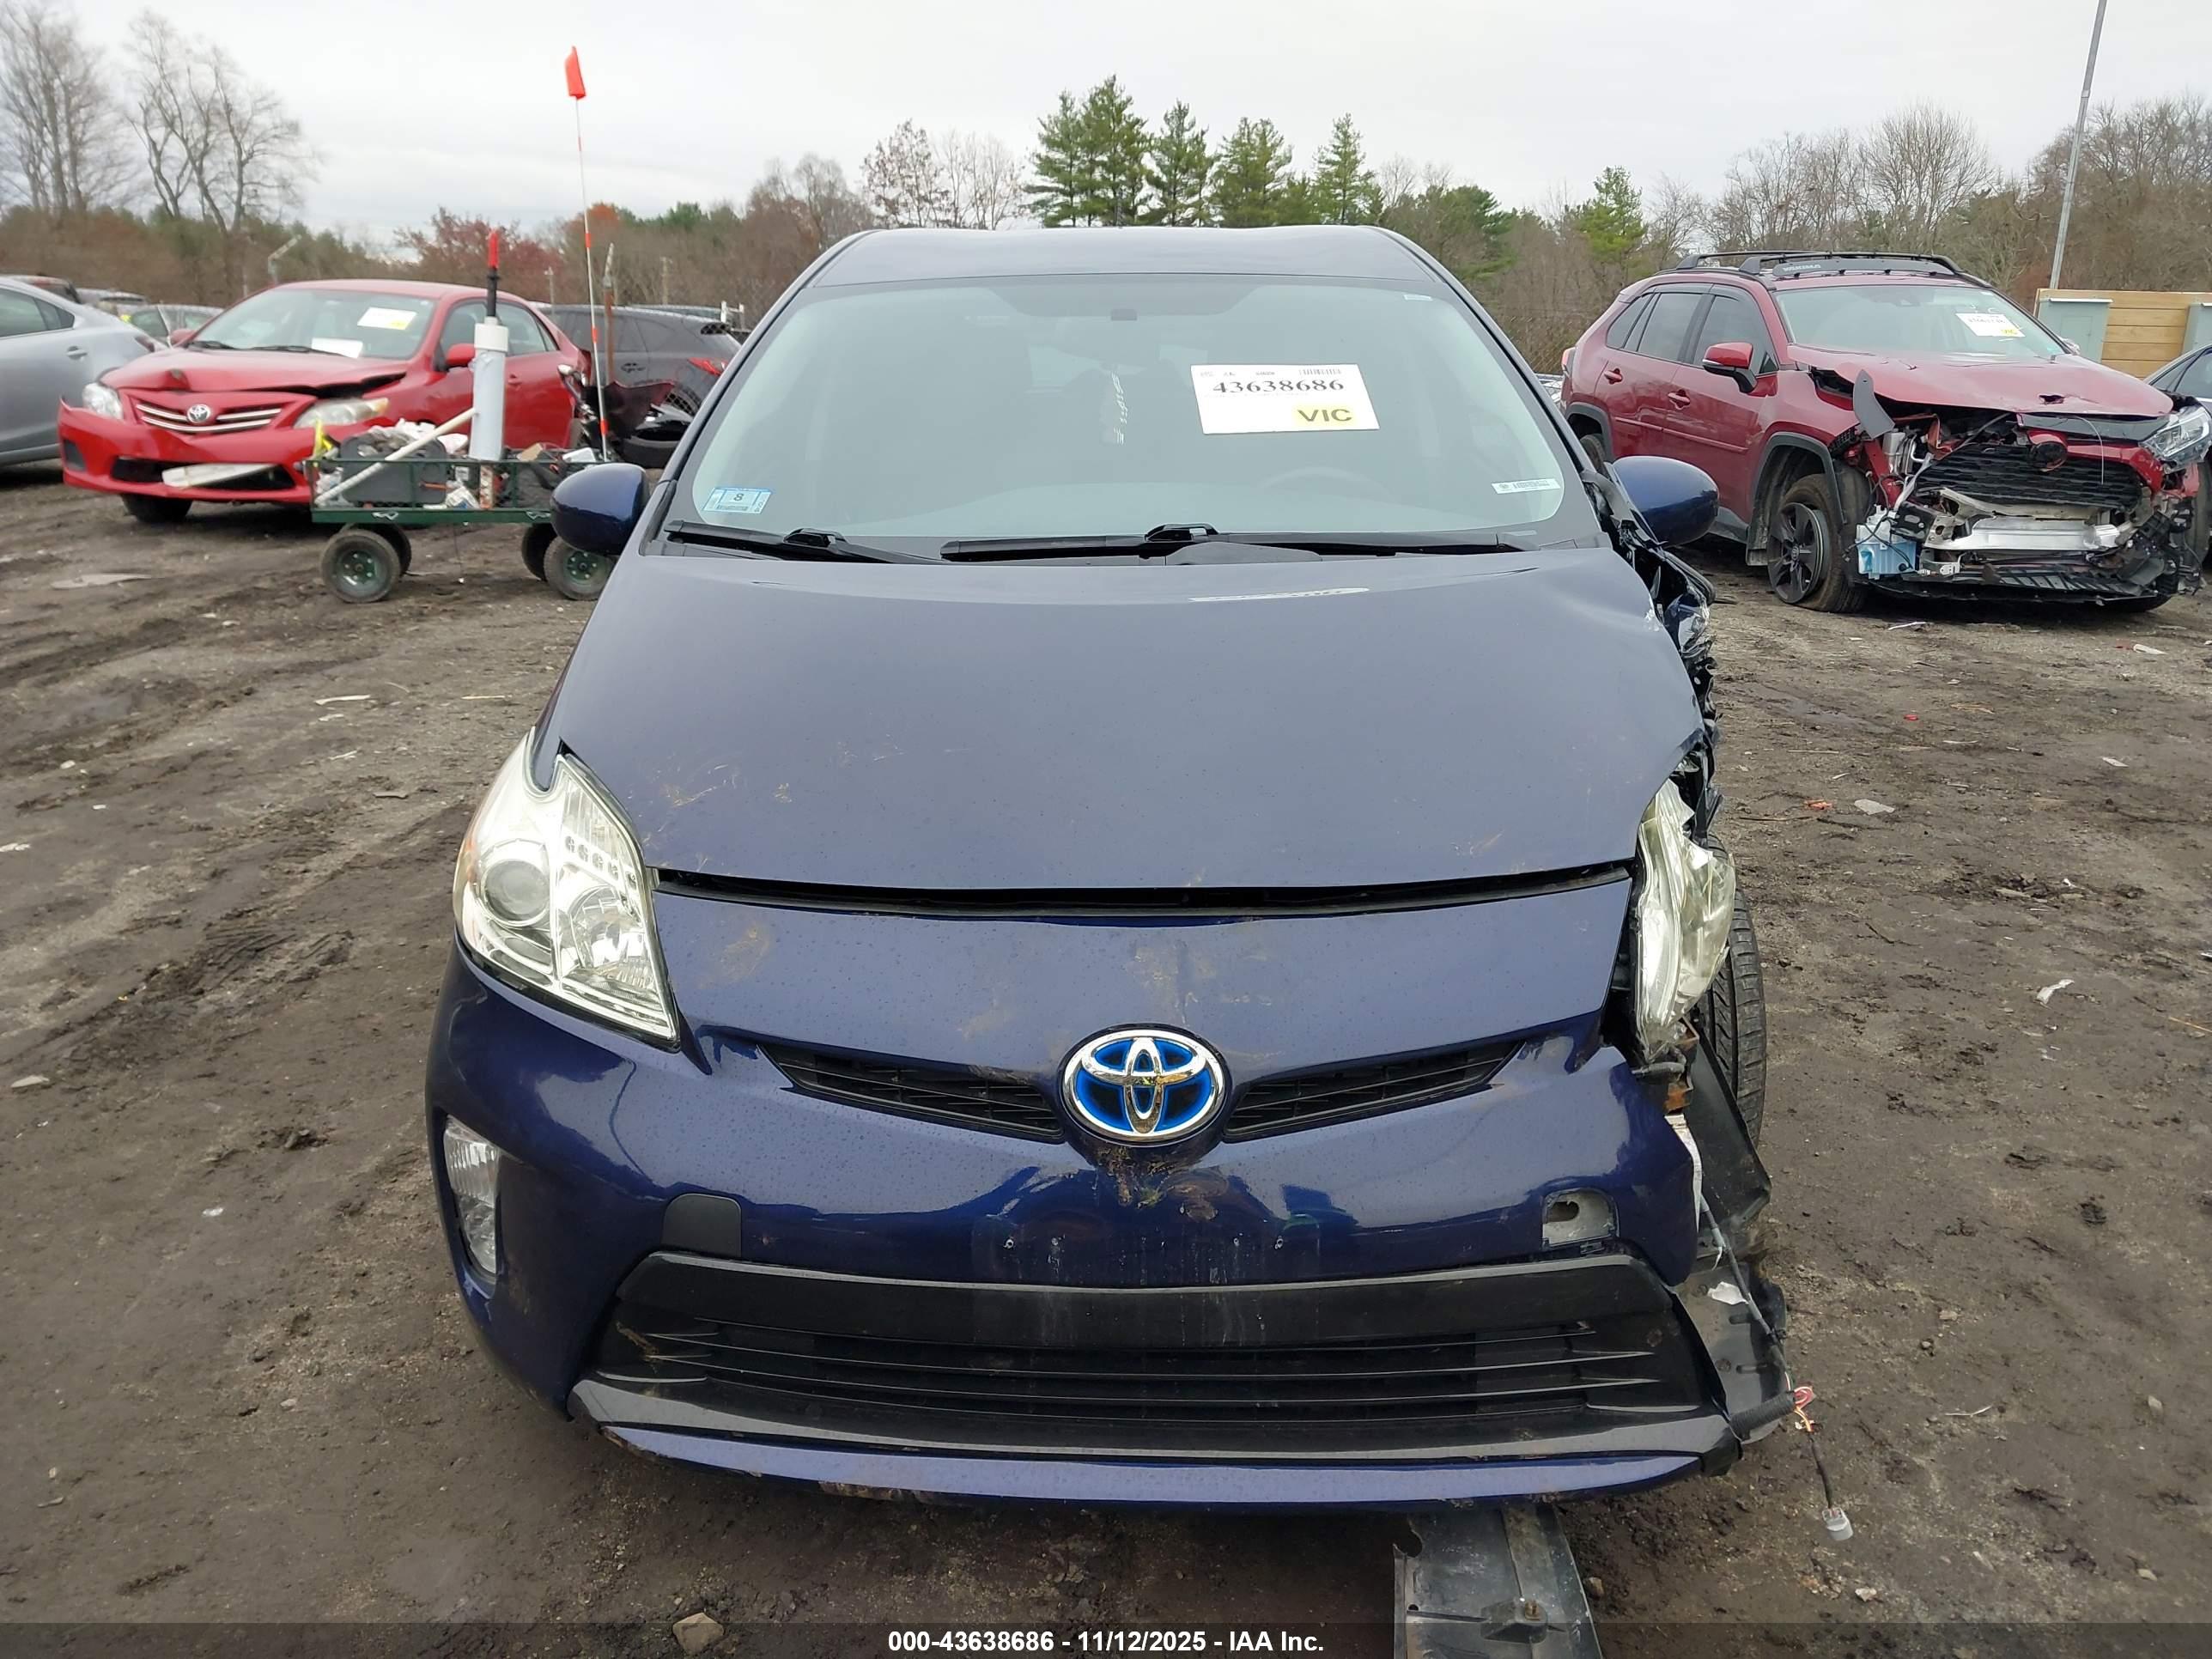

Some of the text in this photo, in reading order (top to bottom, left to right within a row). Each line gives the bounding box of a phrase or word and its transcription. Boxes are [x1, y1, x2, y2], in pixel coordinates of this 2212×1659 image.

[1212, 380, 1345, 393] 43638686
[1297, 409, 1352, 422] VIC
[733, 493, 744, 501] 8
